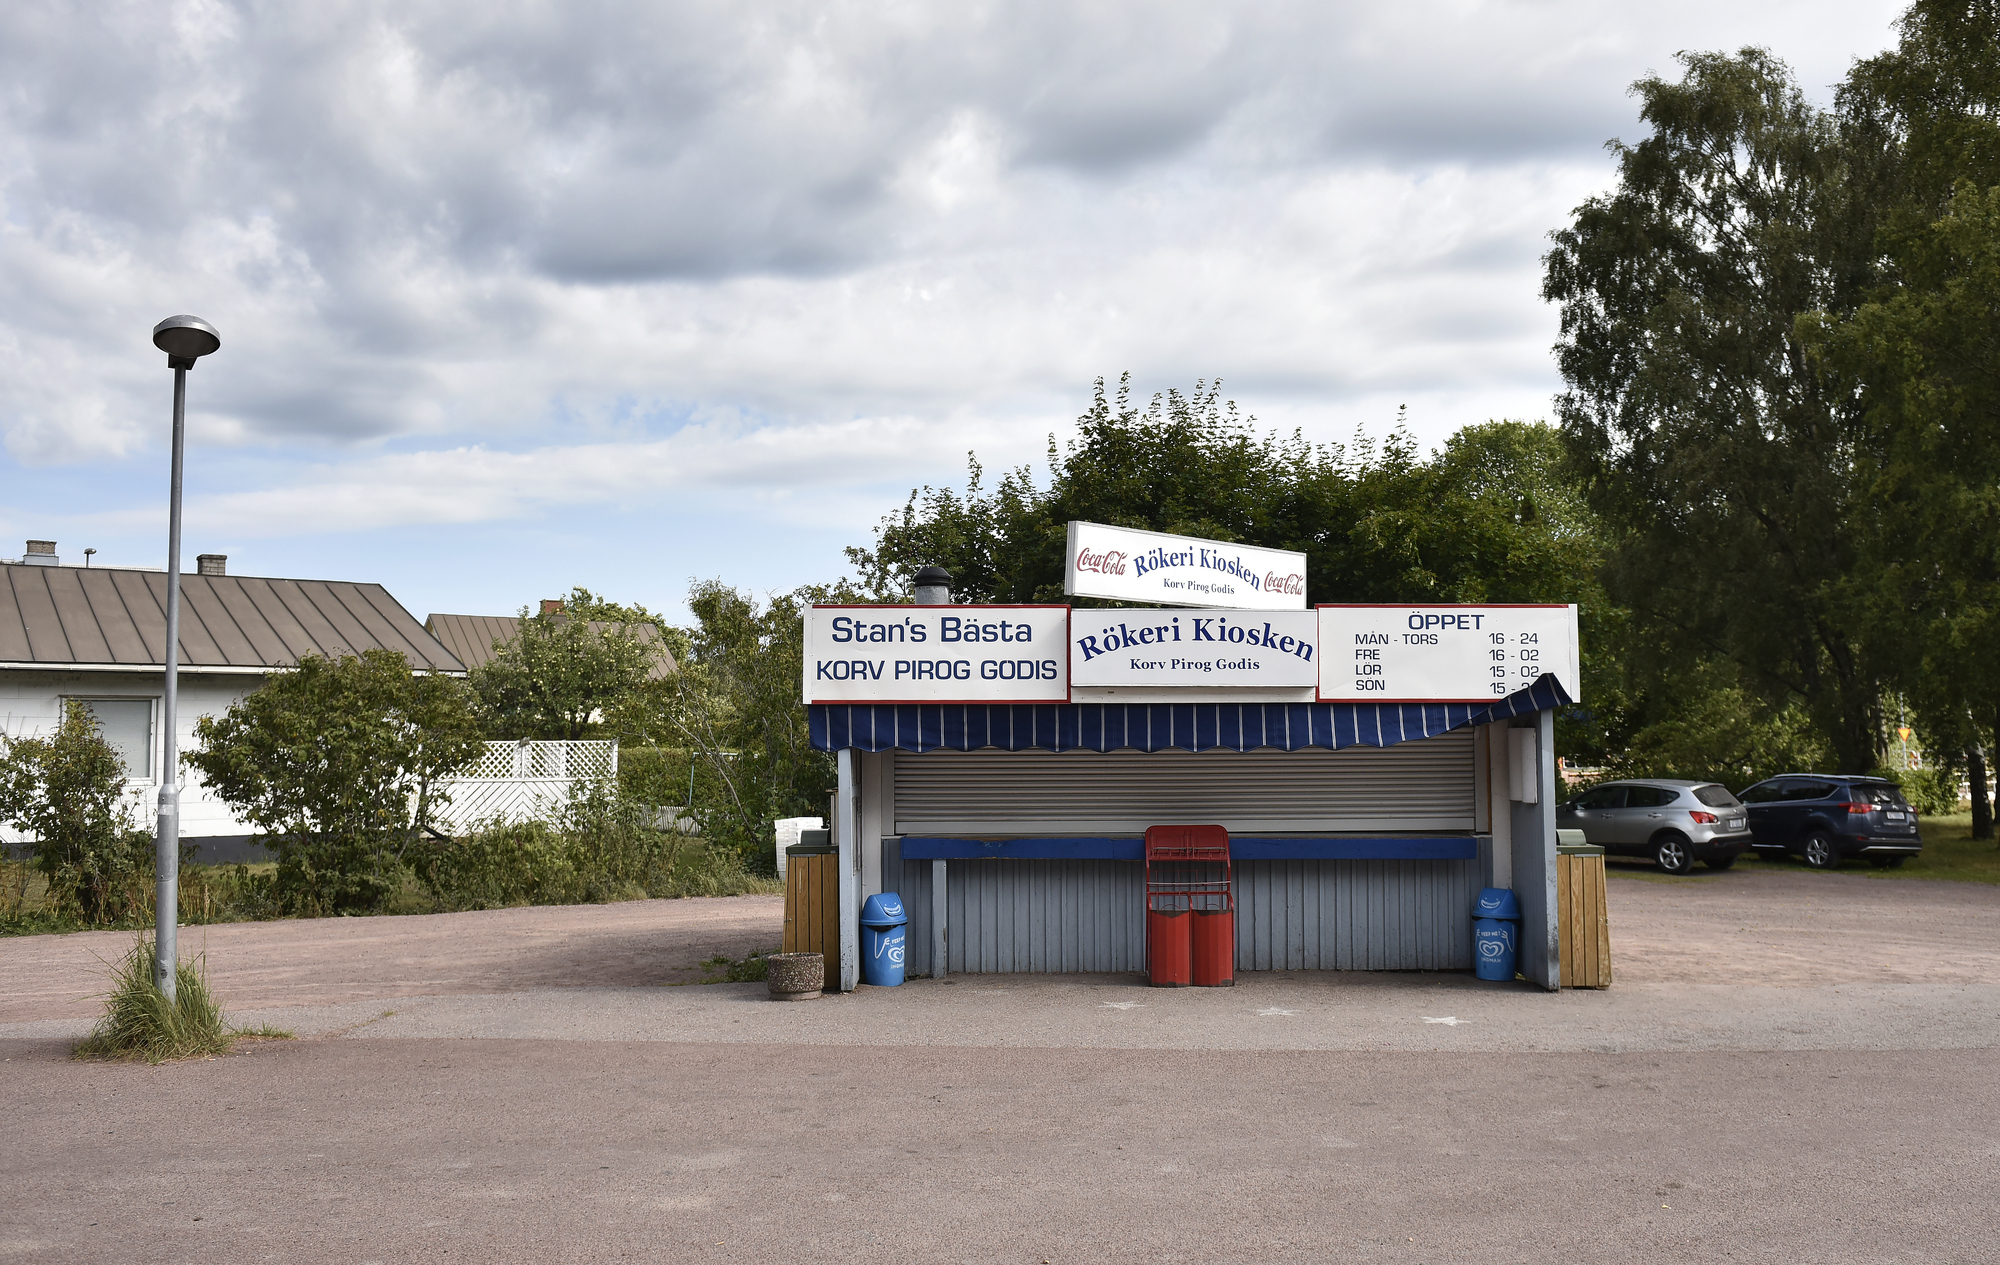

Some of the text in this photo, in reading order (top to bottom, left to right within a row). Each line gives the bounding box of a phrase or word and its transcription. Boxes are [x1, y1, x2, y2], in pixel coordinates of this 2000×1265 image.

[1076, 546, 1128, 575] Coca-Cola
[1133, 546, 1261, 591] Rökeri Kiosken
[1163, 578, 1235, 595] Korv Pirog Godis
[1263, 570, 1304, 596] Coca-Cola
[940, 616, 1032, 643] Bästa
[1408, 610, 1485, 630] ÖPPET
[1076, 616, 1314, 663] Rökeri Kiosken
[1355, 630, 1389, 645] MÅN
[1402, 633, 1438, 645] TORS
[1488, 633, 1505, 645] 16
[1520, 633, 1539, 645] 24
[1355, 649, 1381, 660] FRE
[1488, 649, 1505, 661] 16
[1520, 649, 1539, 661] 02
[816, 660, 1058, 680] KORV PIROG GODIS
[1130, 658, 1260, 673] Korv Pirog Godis
[1355, 661, 1382, 675] LÖR
[1489, 665, 1505, 678] 15
[1520, 665, 1540, 678] 02
[1355, 677, 1385, 691] SÖN
[1489, 682, 1506, 694] 15
